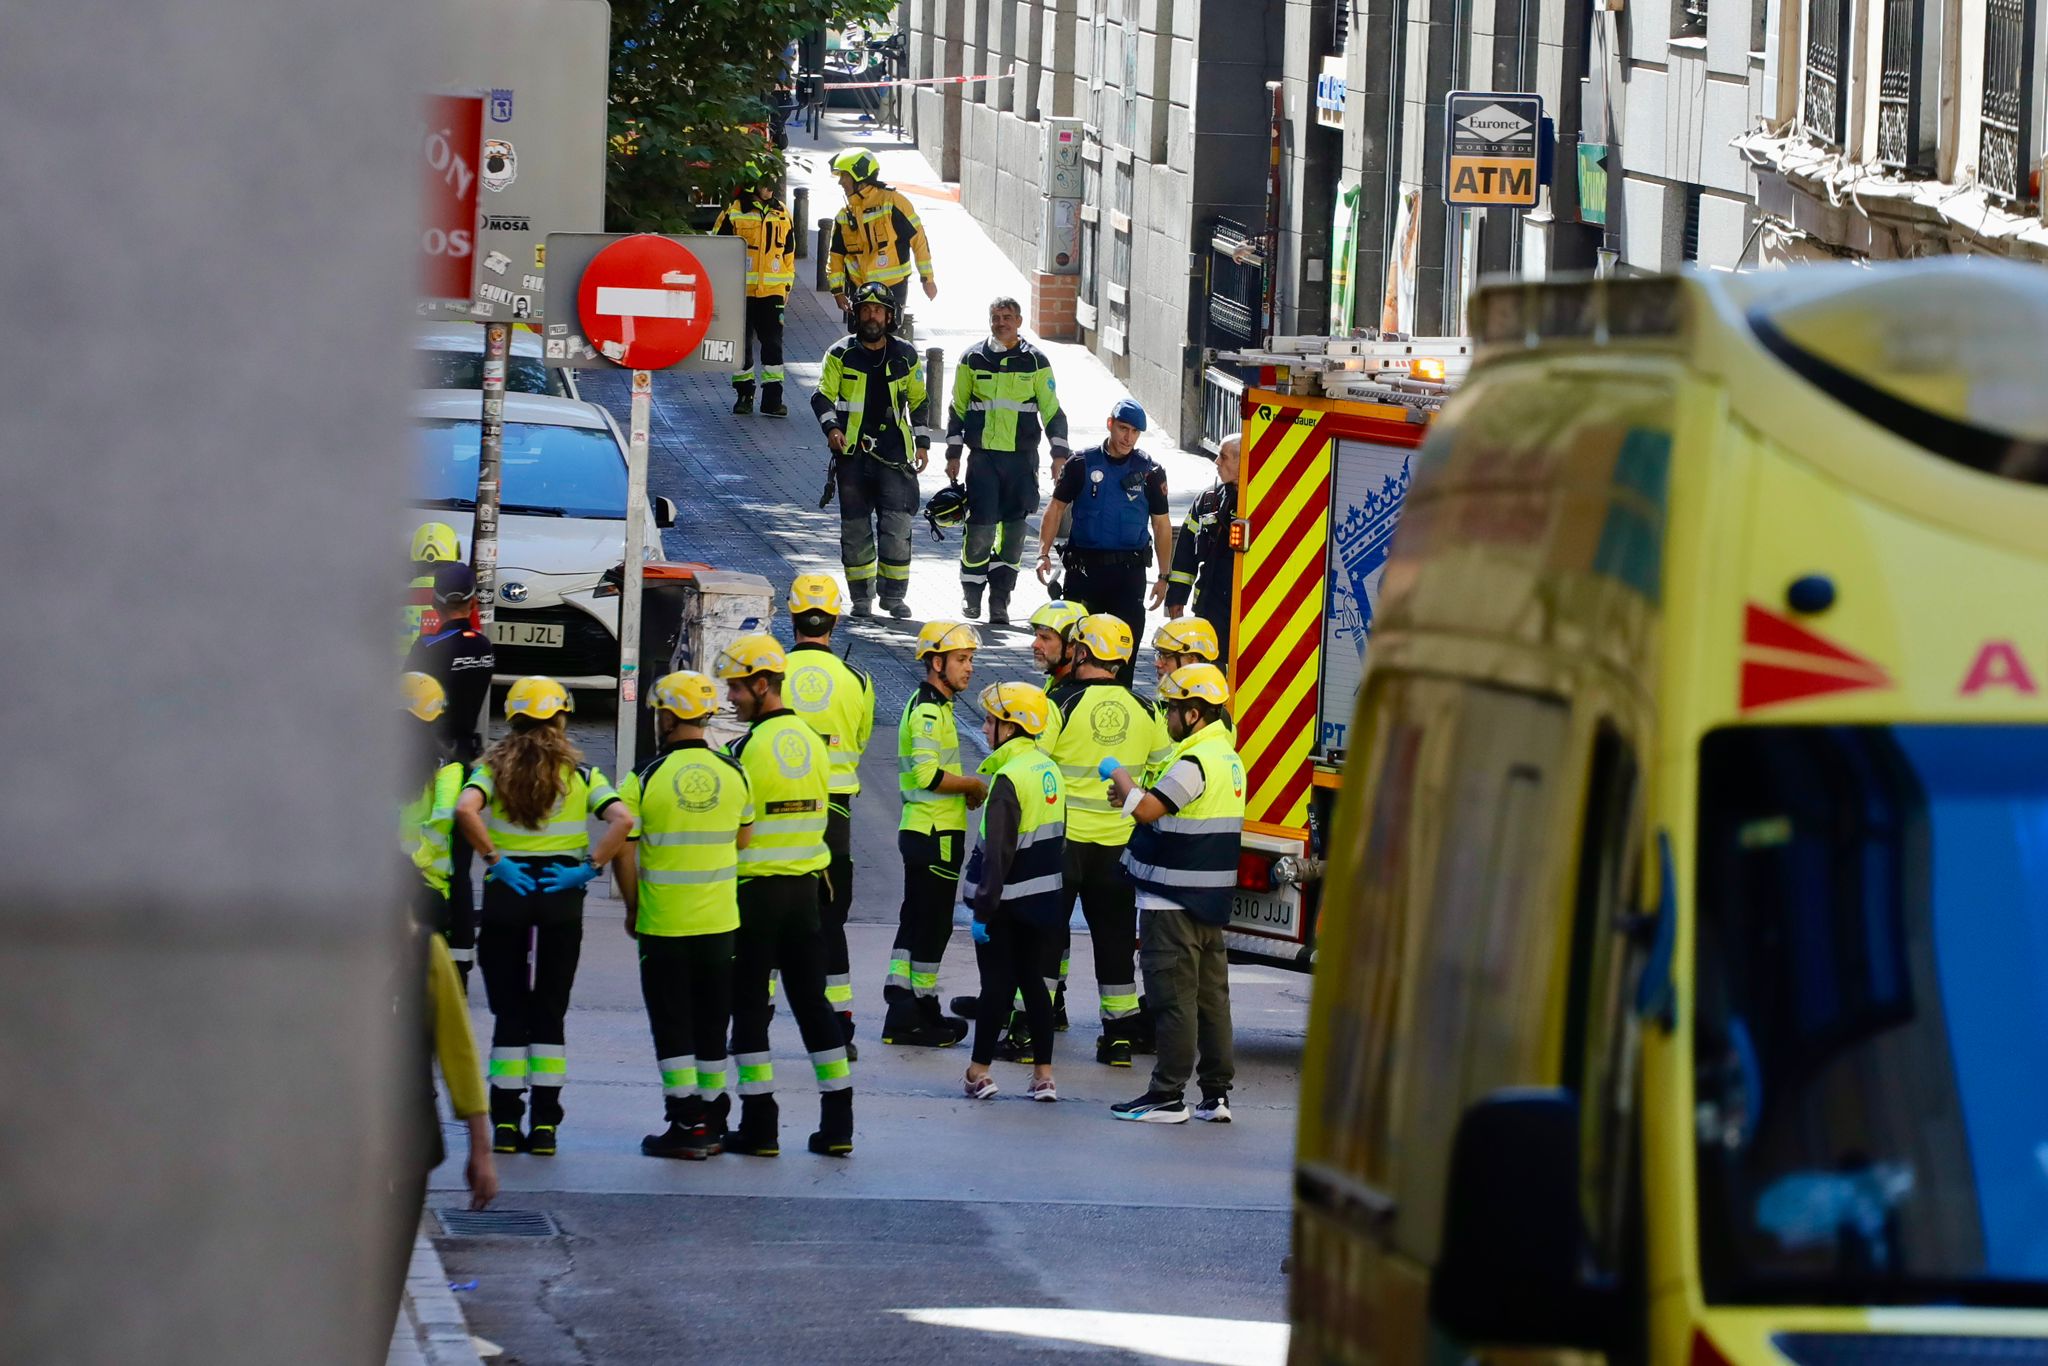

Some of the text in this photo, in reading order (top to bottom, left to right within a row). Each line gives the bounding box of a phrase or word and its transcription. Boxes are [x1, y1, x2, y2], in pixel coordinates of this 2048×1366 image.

[1469, 116, 1521, 130] Euronet
[1455, 144, 1532, 152] WORLDWIDE
[1453, 166, 1532, 196] ATM
[489, 221, 529, 231] MOSA
[703, 339, 733, 362] TM54
[524, 626, 557, 644] JZL
[1321, 721, 1347, 748] PT
[1263, 902, 1290, 925] JJJ
